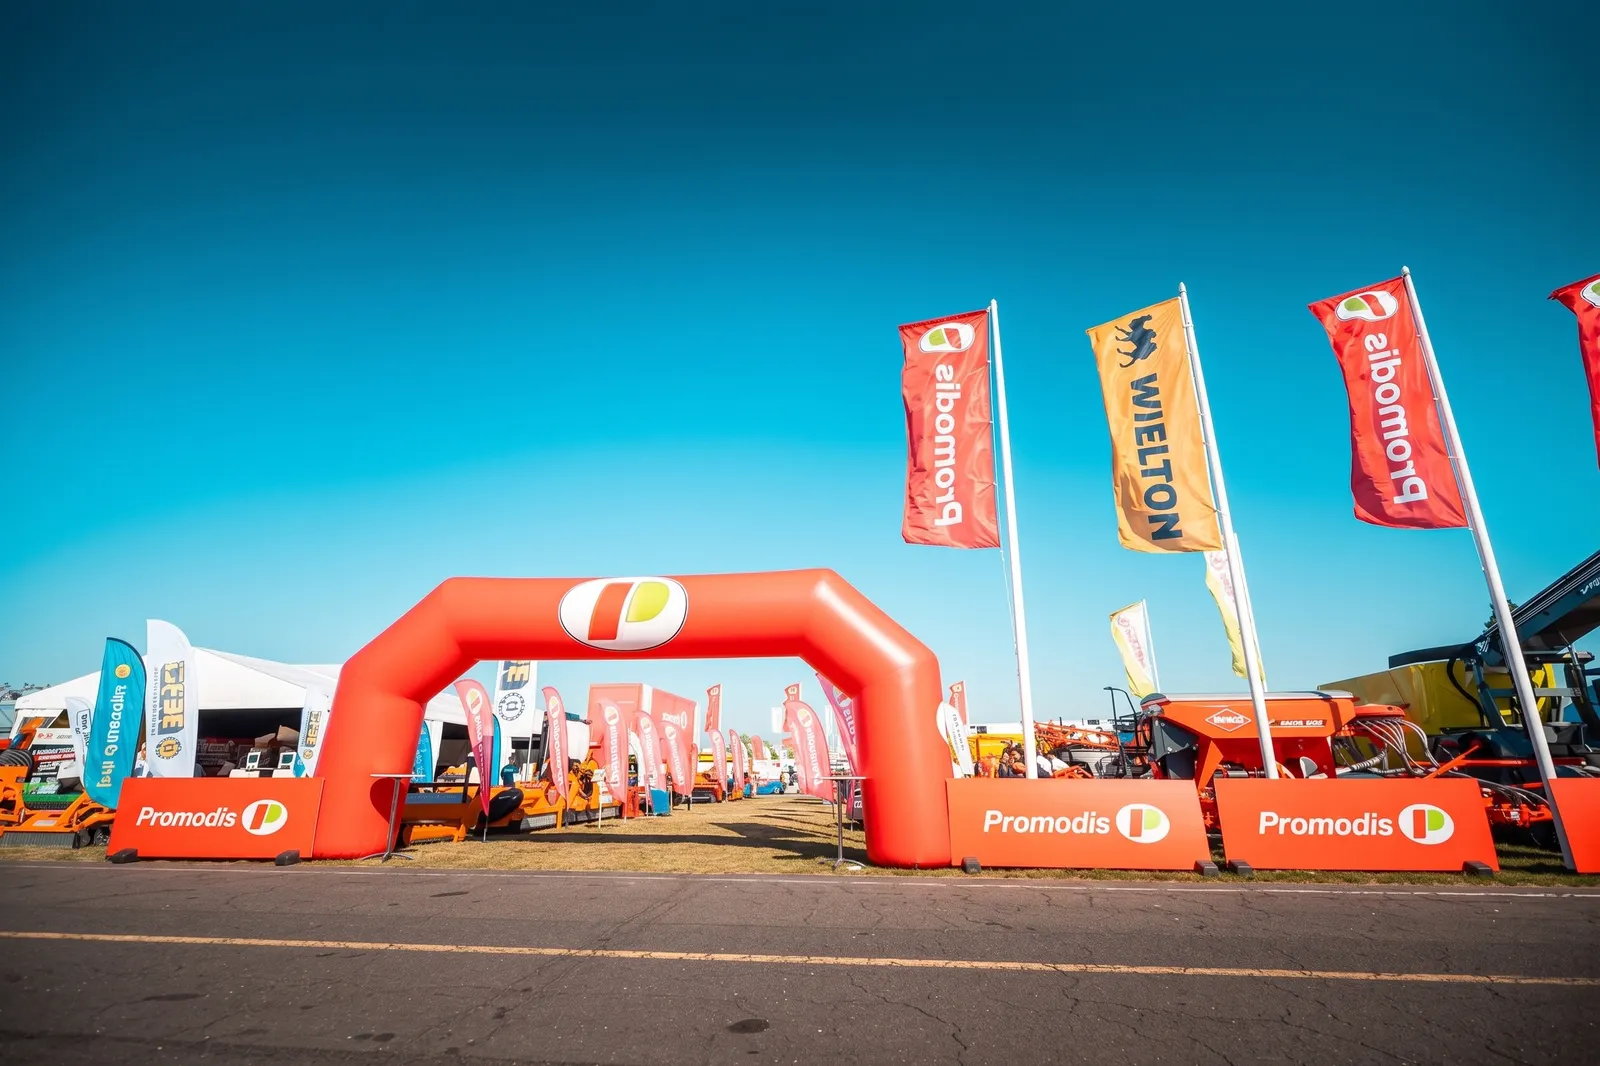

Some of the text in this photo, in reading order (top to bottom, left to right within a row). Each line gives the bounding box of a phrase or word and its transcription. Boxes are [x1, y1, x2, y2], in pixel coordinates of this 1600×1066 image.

[1131, 372, 1184, 542] WIELTON
[135, 806, 238, 828] Promodis
[983, 809, 1111, 835] Promodis
[1258, 811, 1394, 836] Promodis
